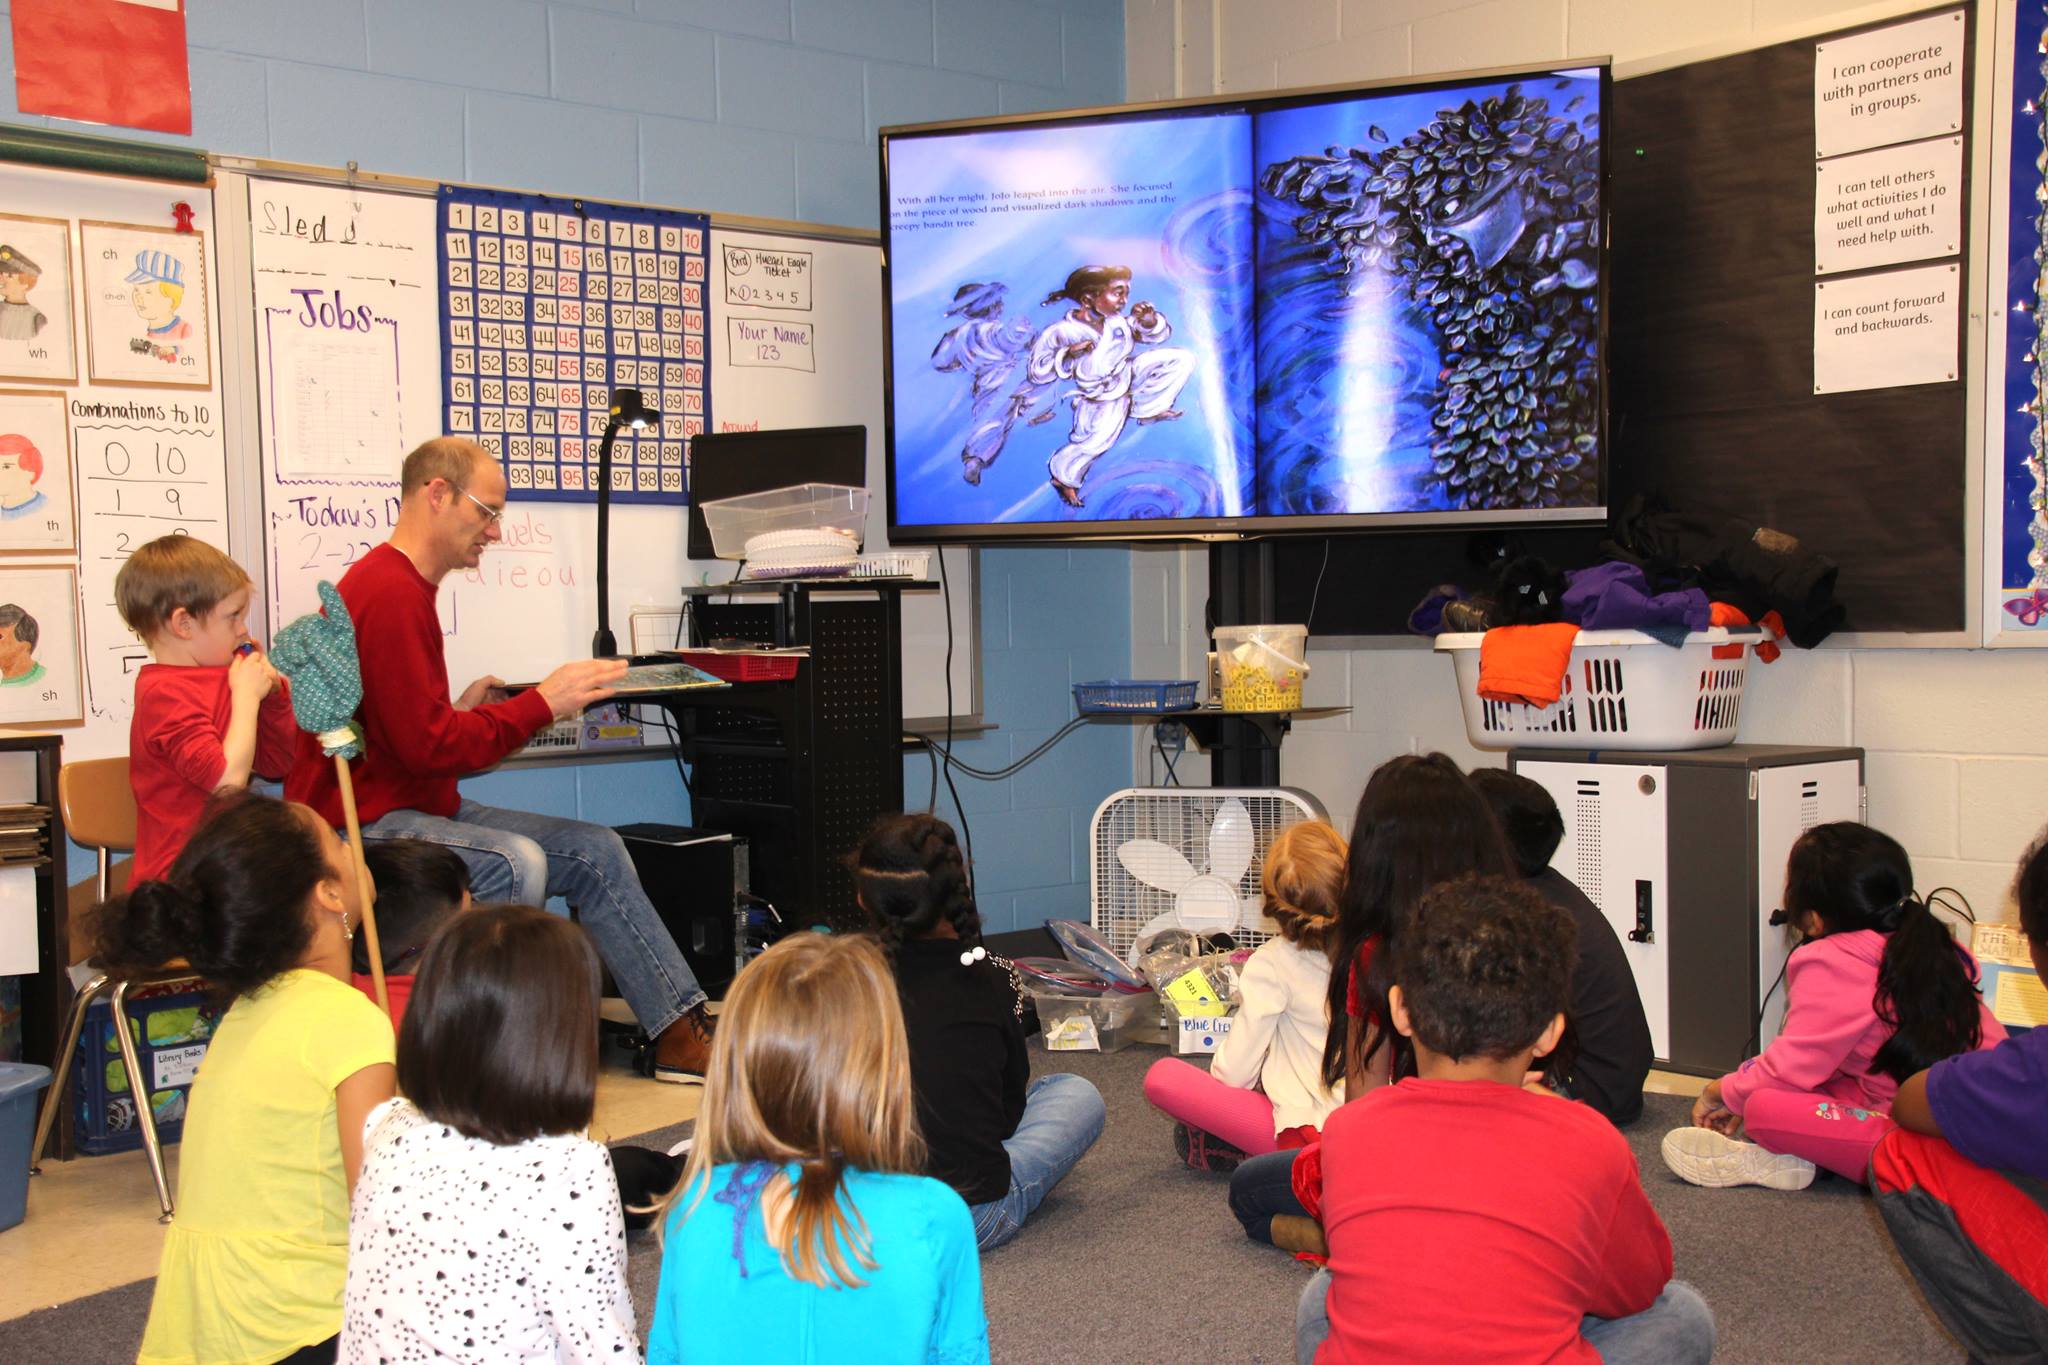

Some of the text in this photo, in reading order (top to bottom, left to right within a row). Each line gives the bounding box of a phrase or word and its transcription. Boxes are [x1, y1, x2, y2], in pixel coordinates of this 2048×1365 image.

[1833, 46, 1942, 79] I can cooperate
[1824, 62, 1951, 102] with partners and
[1851, 94, 1920, 116] in groups.
[898, 197, 921, 205] With
[925, 196, 936, 204] all
[939, 195, 954, 203] her
[1013, 190, 1046, 200] leaped
[1110, 184, 1129, 193] She
[1133, 181, 1172, 192] focused
[1838, 170, 1935, 195] I can tell others
[922, 210, 946, 218] piece
[961, 205, 988, 214] wood
[990, 204, 1009, 213] and
[1012, 202, 1061, 212] visualized
[1064, 200, 1086, 209] dark
[1091, 199, 1134, 208] shadows
[1137, 196, 1157, 205] and
[1160, 195, 1176, 204] the
[1828, 185, 1946, 214] what activities I do
[456, 208, 699, 249] 1 2 3 4 5 6 7 8 9 10
[923, 221, 953, 229] bandit
[1837, 204, 1934, 230] well and what I
[1838, 223, 1933, 248] need help with.
[103, 248, 118, 260] ch
[452, 238, 703, 277] 11 12 13 14 15 16 17 18 19 20
[452, 266, 699, 304] 21 22 23 24 25 26 27 28 29 30
[753, 289, 760, 298] 2
[766, 290, 772, 301] 3
[777, 292, 784, 301] 4
[791, 292, 798, 304] 5
[290, 288, 372, 334] Jobs
[454, 296, 701, 328] 31 32 33 34 35 36 37 38 39 40
[1824, 292, 1944, 320] I can count forward
[738, 322, 809, 345] Your Name
[1835, 312, 1932, 336] and backwards.
[454, 325, 702, 356] 41 42 43 44 45 46 47 48 49 50
[758, 344, 780, 360] 123
[29, 348, 47, 358] wh
[180, 355, 195, 366] ch
[72, 400, 209, 424] Combinations to 10
[105, 442, 186, 476] 0 10
[116, 489, 182, 515] 1 9
[47, 520, 59, 530] th
[116, 532, 135, 553] 2
[498, 560, 502, 586] i
[510, 566, 528, 588] e
[538, 568, 552, 586] o
[560, 566, 576, 587] u
[42, 690, 57, 701] sh
[1980, 932, 2008, 945] THE
[158, 1054, 182, 1064] Library
